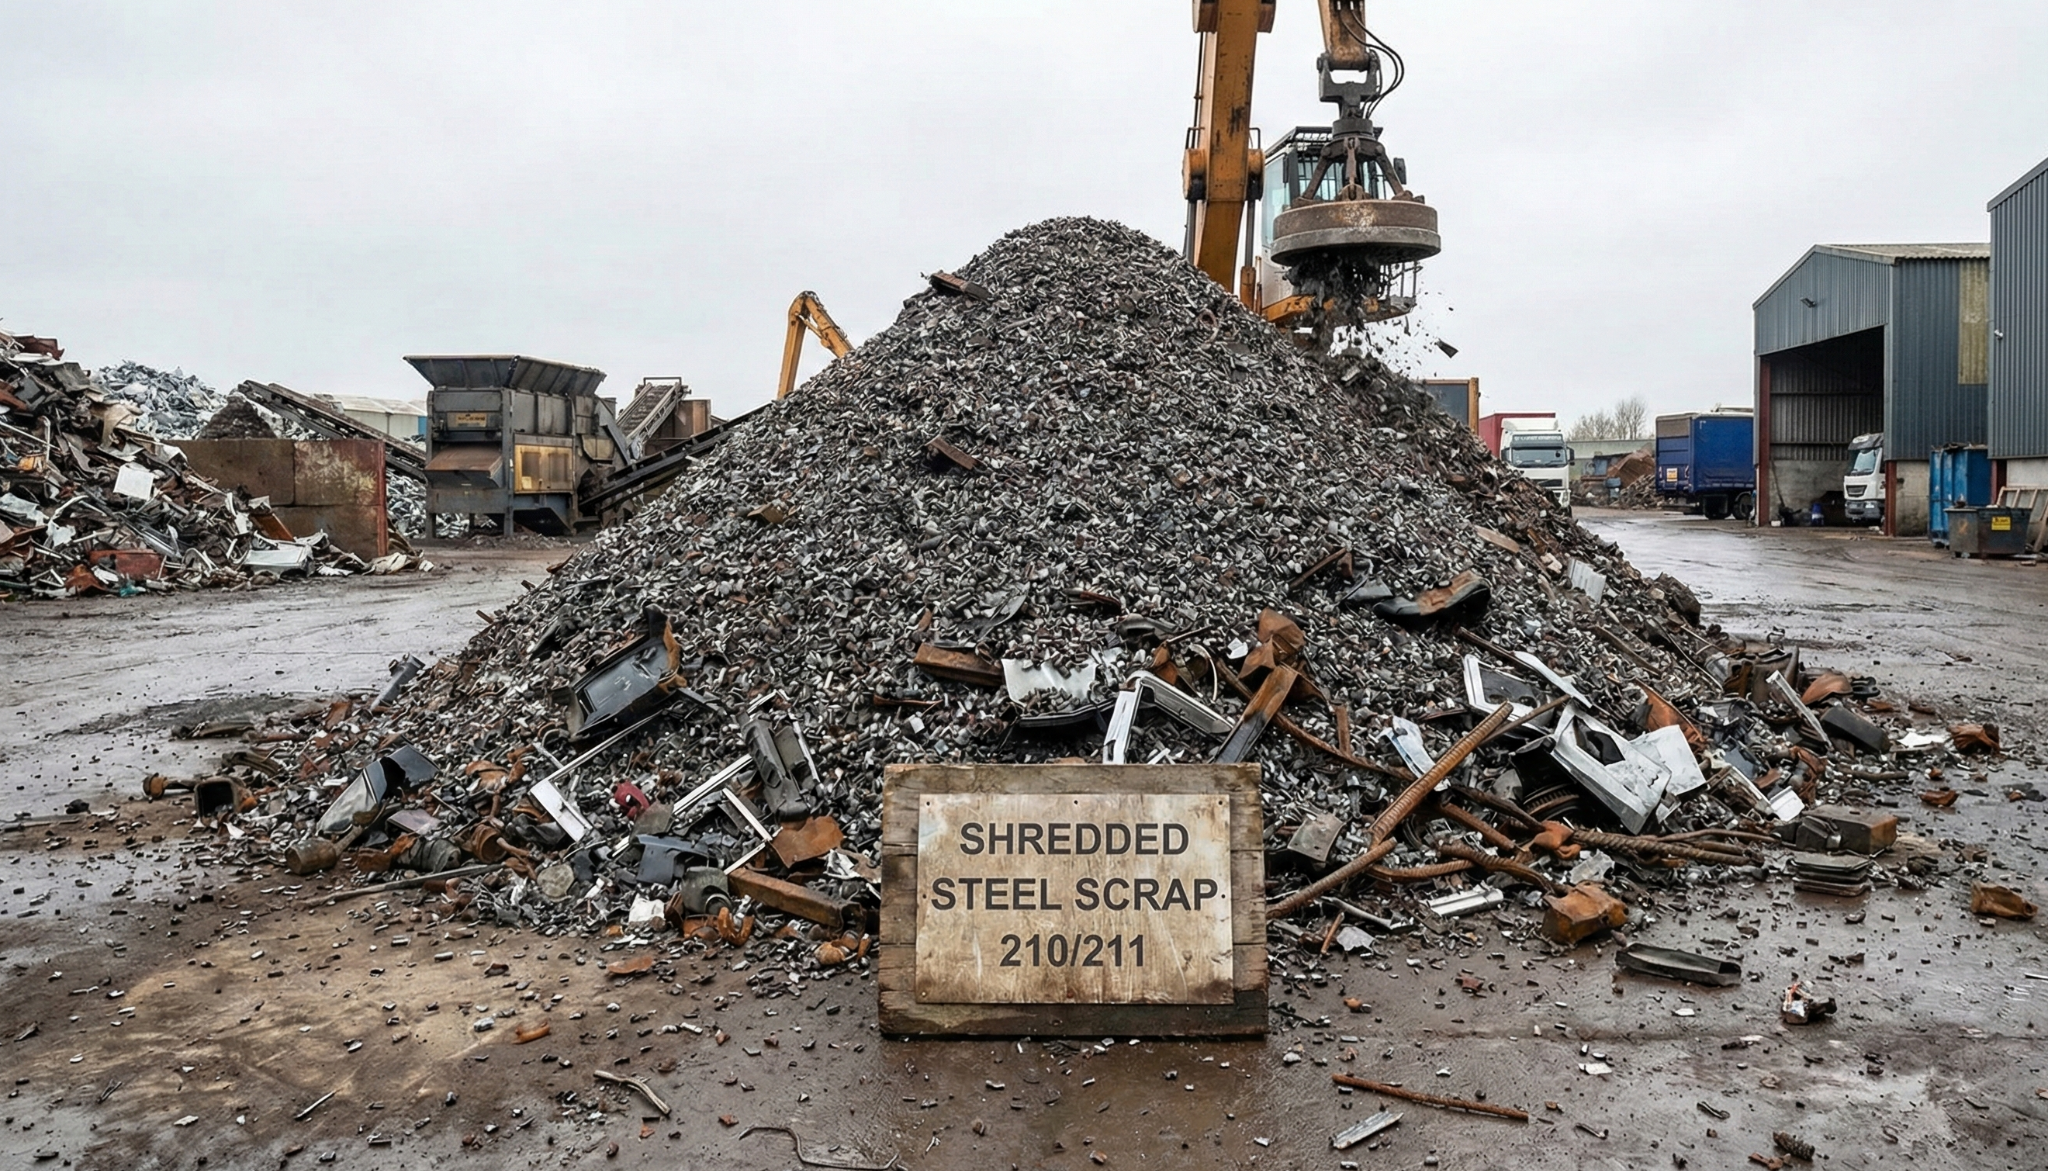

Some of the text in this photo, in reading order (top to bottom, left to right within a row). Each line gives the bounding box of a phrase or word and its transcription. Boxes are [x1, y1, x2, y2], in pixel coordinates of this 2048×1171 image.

[960, 822, 1190, 855] SHREDDED
[931, 877, 1218, 911] STEEL SCRAP
[999, 933, 1144, 967] 210/211
